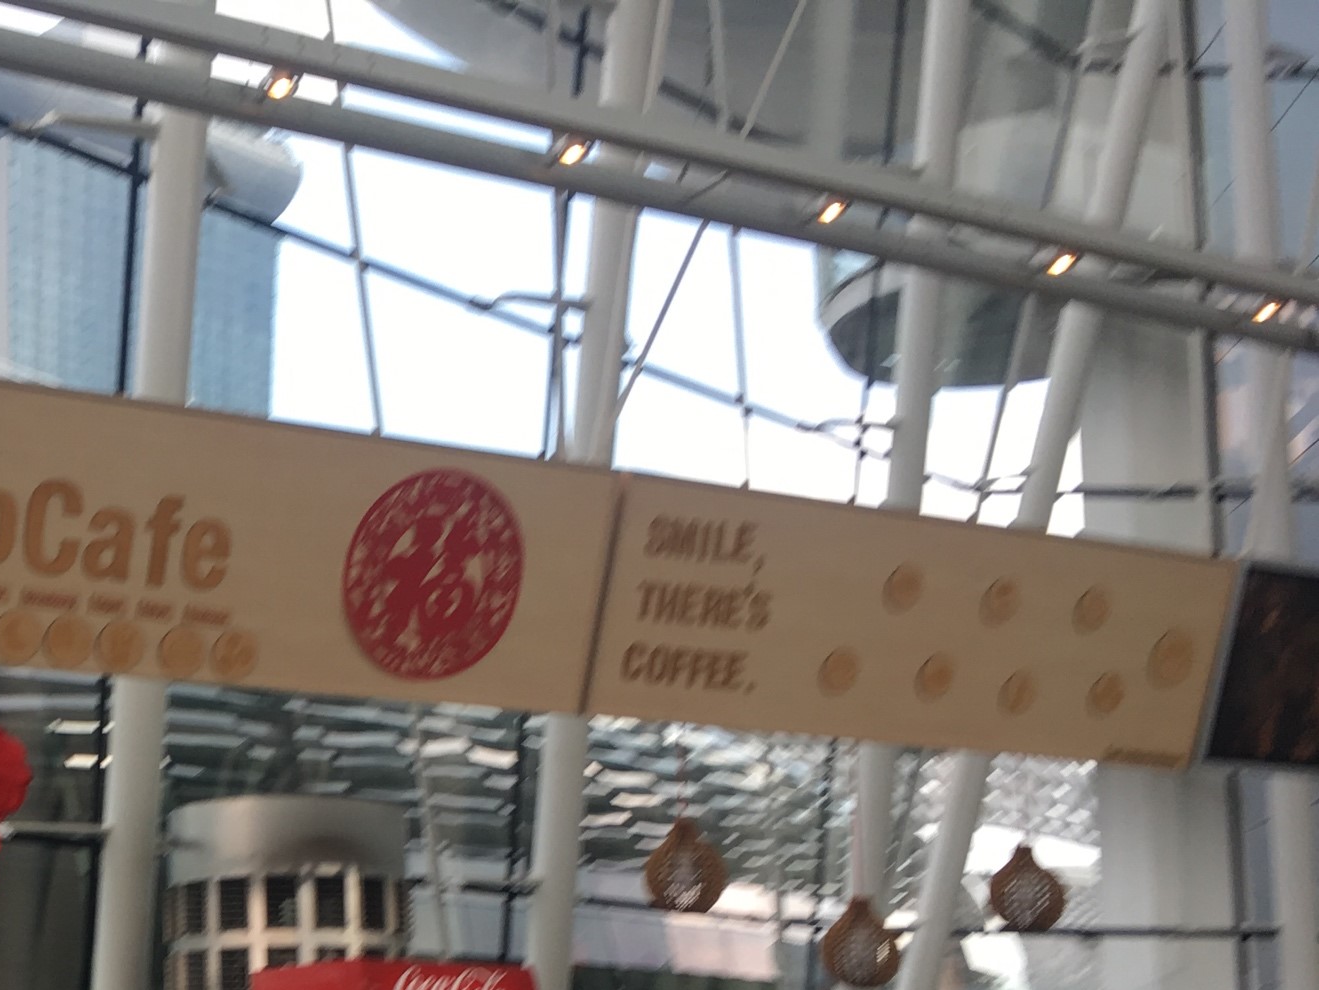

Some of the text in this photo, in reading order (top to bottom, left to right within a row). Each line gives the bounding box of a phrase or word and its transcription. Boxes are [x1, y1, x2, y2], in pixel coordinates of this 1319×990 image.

[643, 514, 765, 574] SMILE,
[637, 579, 771, 630] THERE'S
[619, 641, 756, 694] COFFEE.
